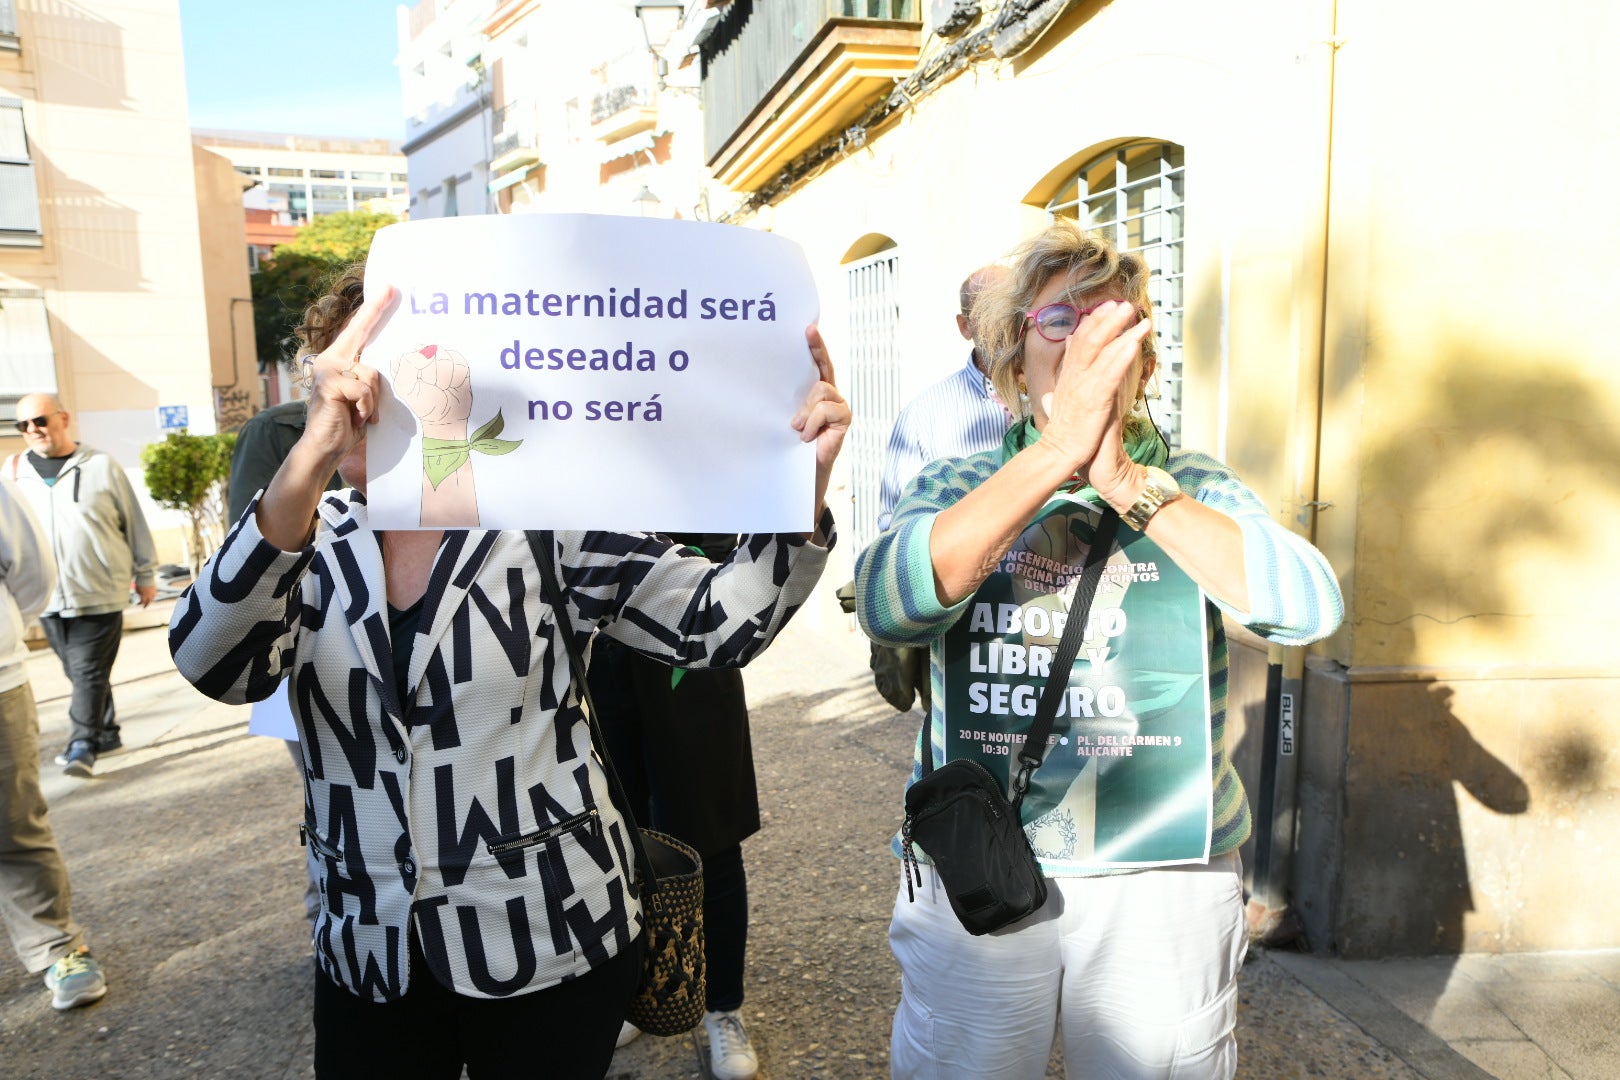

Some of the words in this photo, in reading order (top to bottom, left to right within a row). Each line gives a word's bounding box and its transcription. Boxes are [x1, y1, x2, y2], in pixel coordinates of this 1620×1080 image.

[410, 287, 449, 315] La
[463, 287, 688, 319] maternidad
[700, 292, 777, 321] será
[500, 340, 656, 372] deseada
[668, 349, 690, 372] o
[527, 399, 573, 421] no
[585, 394, 663, 422] será
[1005, 562, 1054, 585] OFICINA
[1024, 578, 1047, 594] DEL
[970, 642, 1074, 678] LIBR
[1086, 646, 1111, 677] Y
[959, 729, 971, 740] 20
[973, 730, 987, 741] DE
[1077, 735, 1094, 746] PL.
[1097, 735, 1119, 746] DEL
[1121, 735, 1171, 746] CARMEN
[1173, 735, 1182, 746] 9
[981, 743, 1009, 756] 10:30
[1077, 746, 1133, 757] ALICANTE
